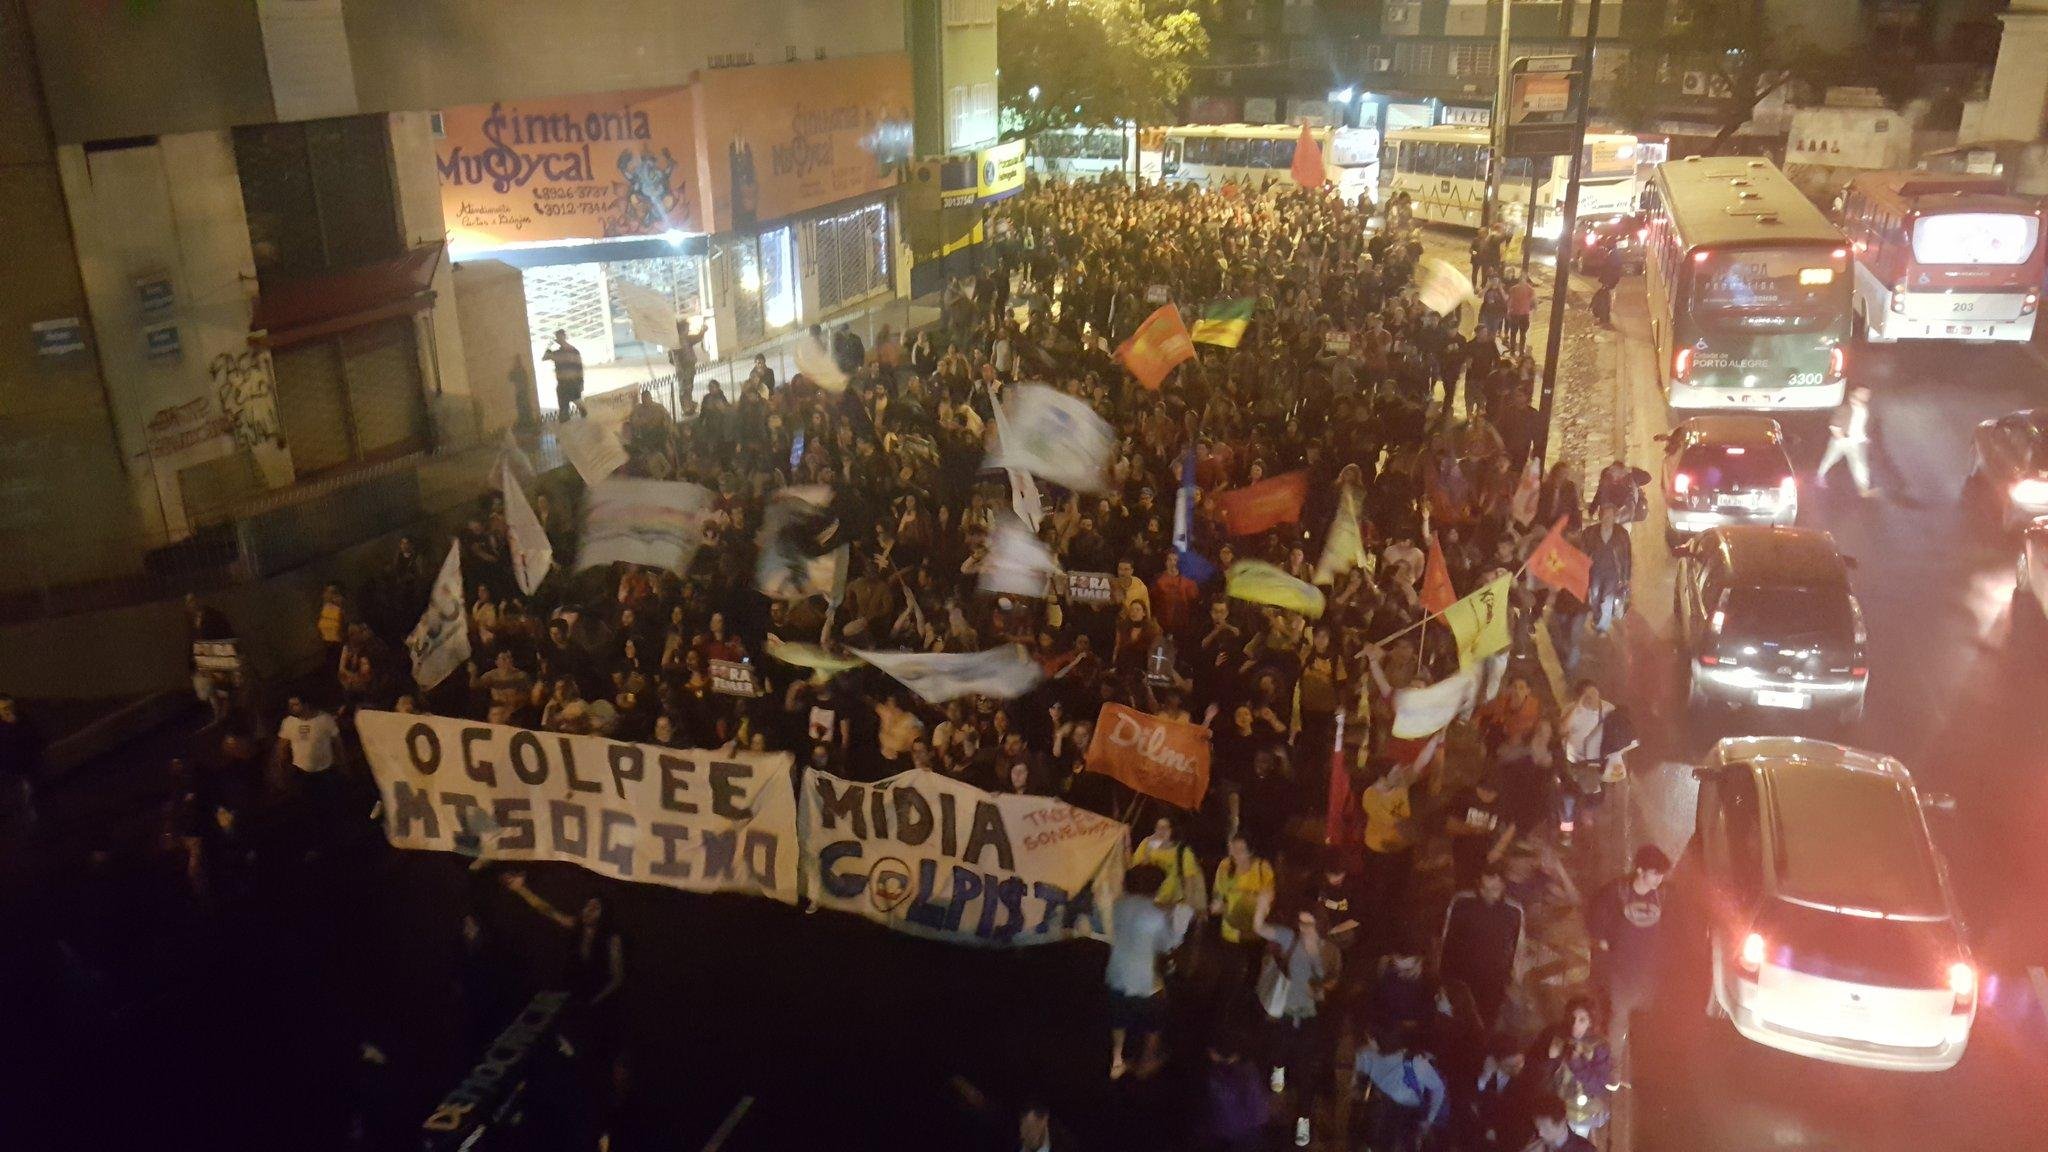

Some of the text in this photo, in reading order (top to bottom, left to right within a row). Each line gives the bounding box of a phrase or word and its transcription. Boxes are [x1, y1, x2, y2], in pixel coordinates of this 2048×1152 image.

[1953, 303, 1974, 311] 203
[1693, 359, 1769, 368] PORTO ALEGRE
[1788, 373, 1823, 385] 3300
[405, 722, 442, 775] O
[461, 727, 698, 814] GOLPE
[394, 780, 779, 890] MISOGINO
[819, 840, 1104, 940] GOLPISTA
